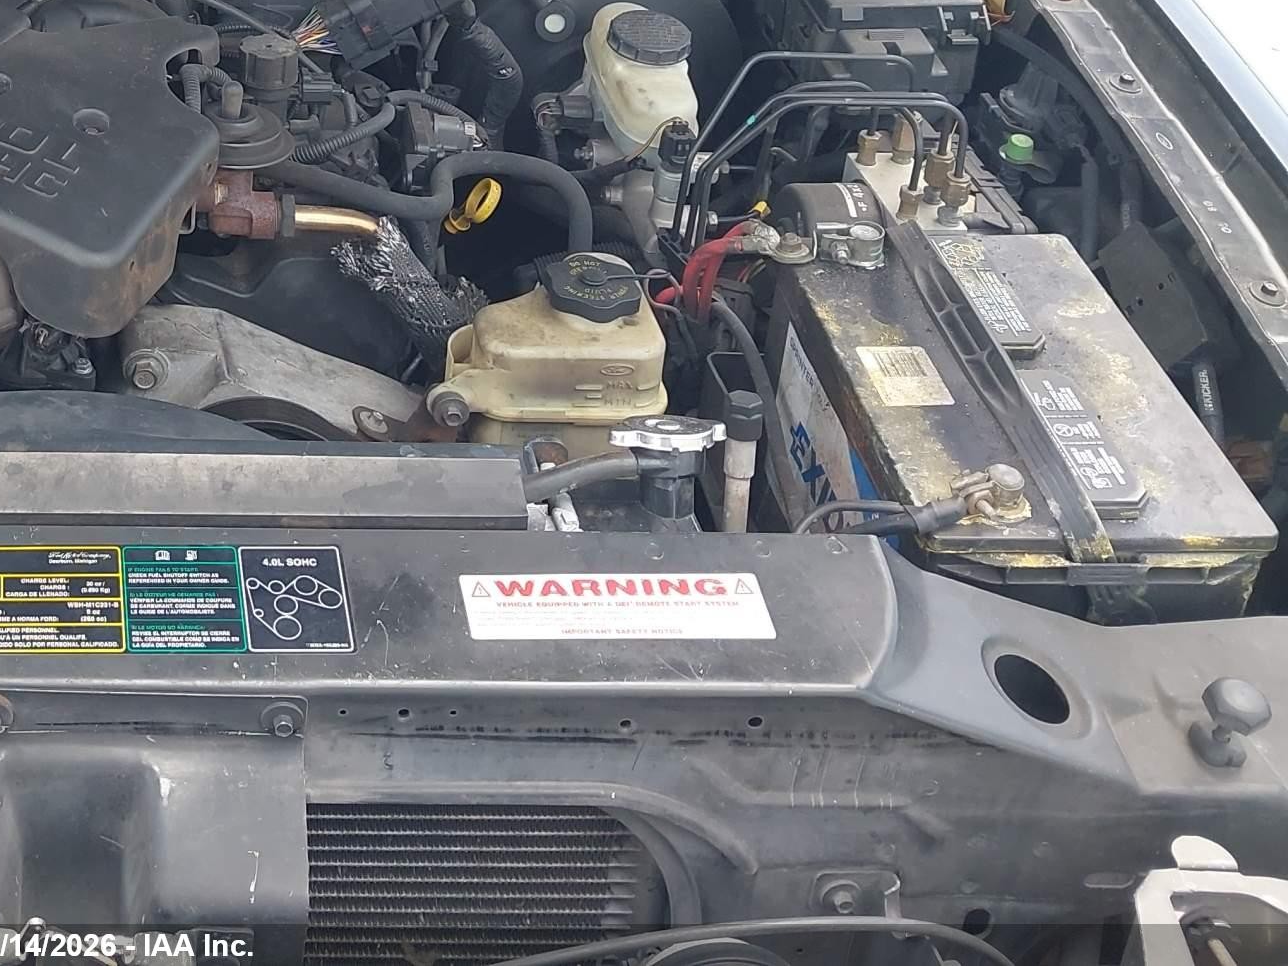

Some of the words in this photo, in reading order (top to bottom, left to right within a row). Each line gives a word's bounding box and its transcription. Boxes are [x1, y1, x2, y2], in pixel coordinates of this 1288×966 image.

[262, 558, 284, 566] 4.0L
[286, 558, 317, 566] SOHC
[494, 578, 727, 596] WARNING
